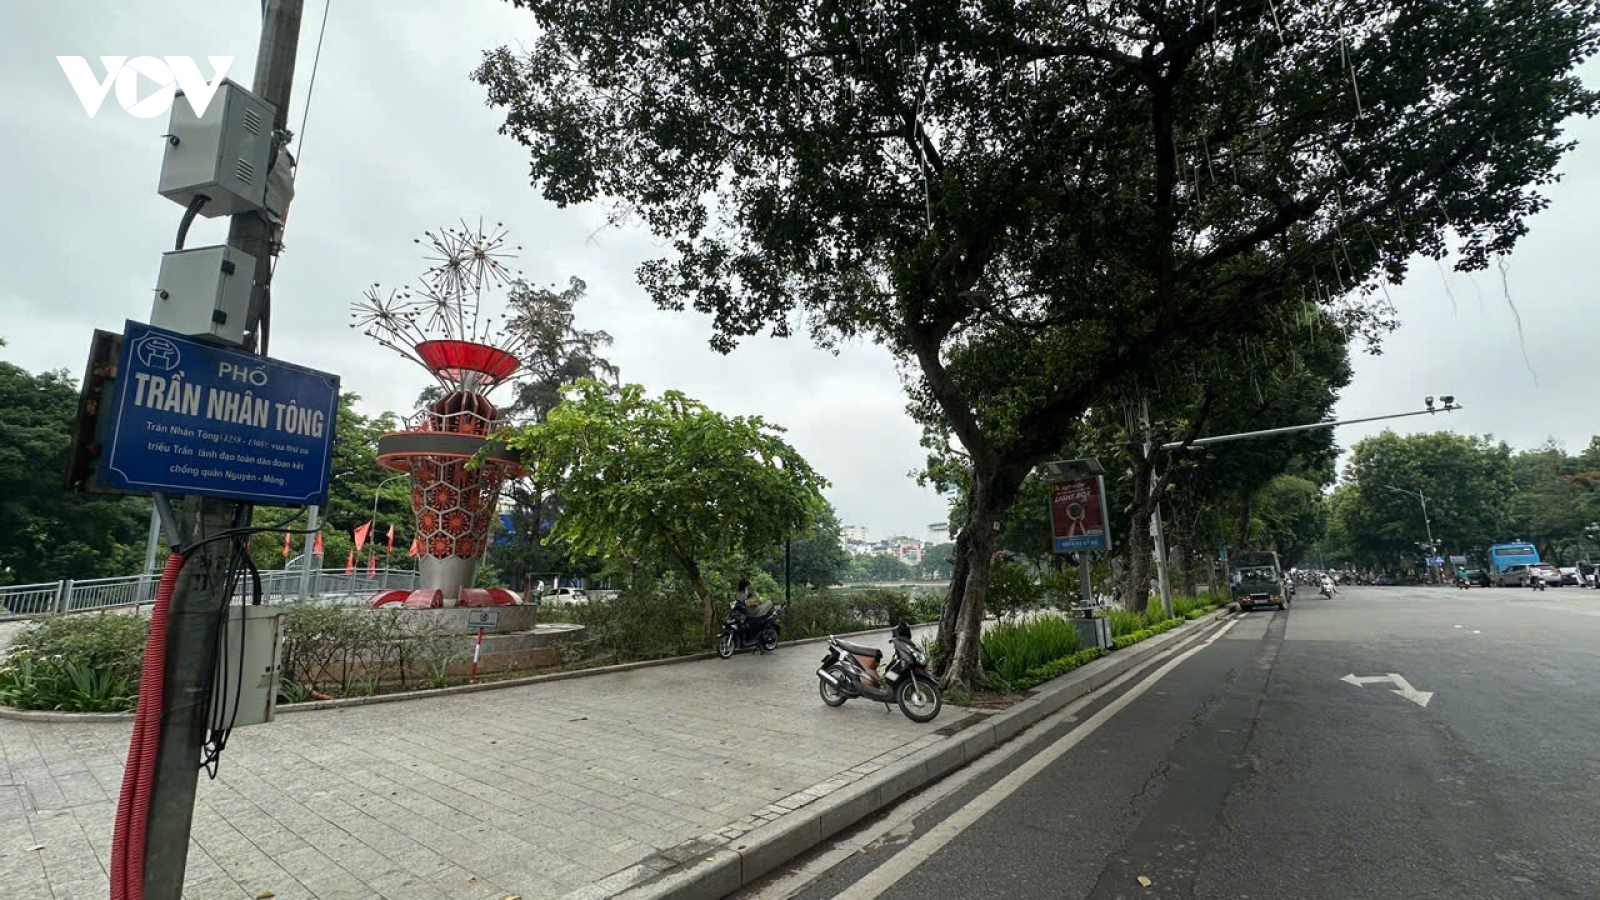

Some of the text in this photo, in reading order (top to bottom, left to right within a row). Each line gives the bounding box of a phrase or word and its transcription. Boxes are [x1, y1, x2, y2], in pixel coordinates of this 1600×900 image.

[219, 361, 268, 387] PHỐ
[134, 370, 324, 438] TRẦN NHÂN TÔNG
